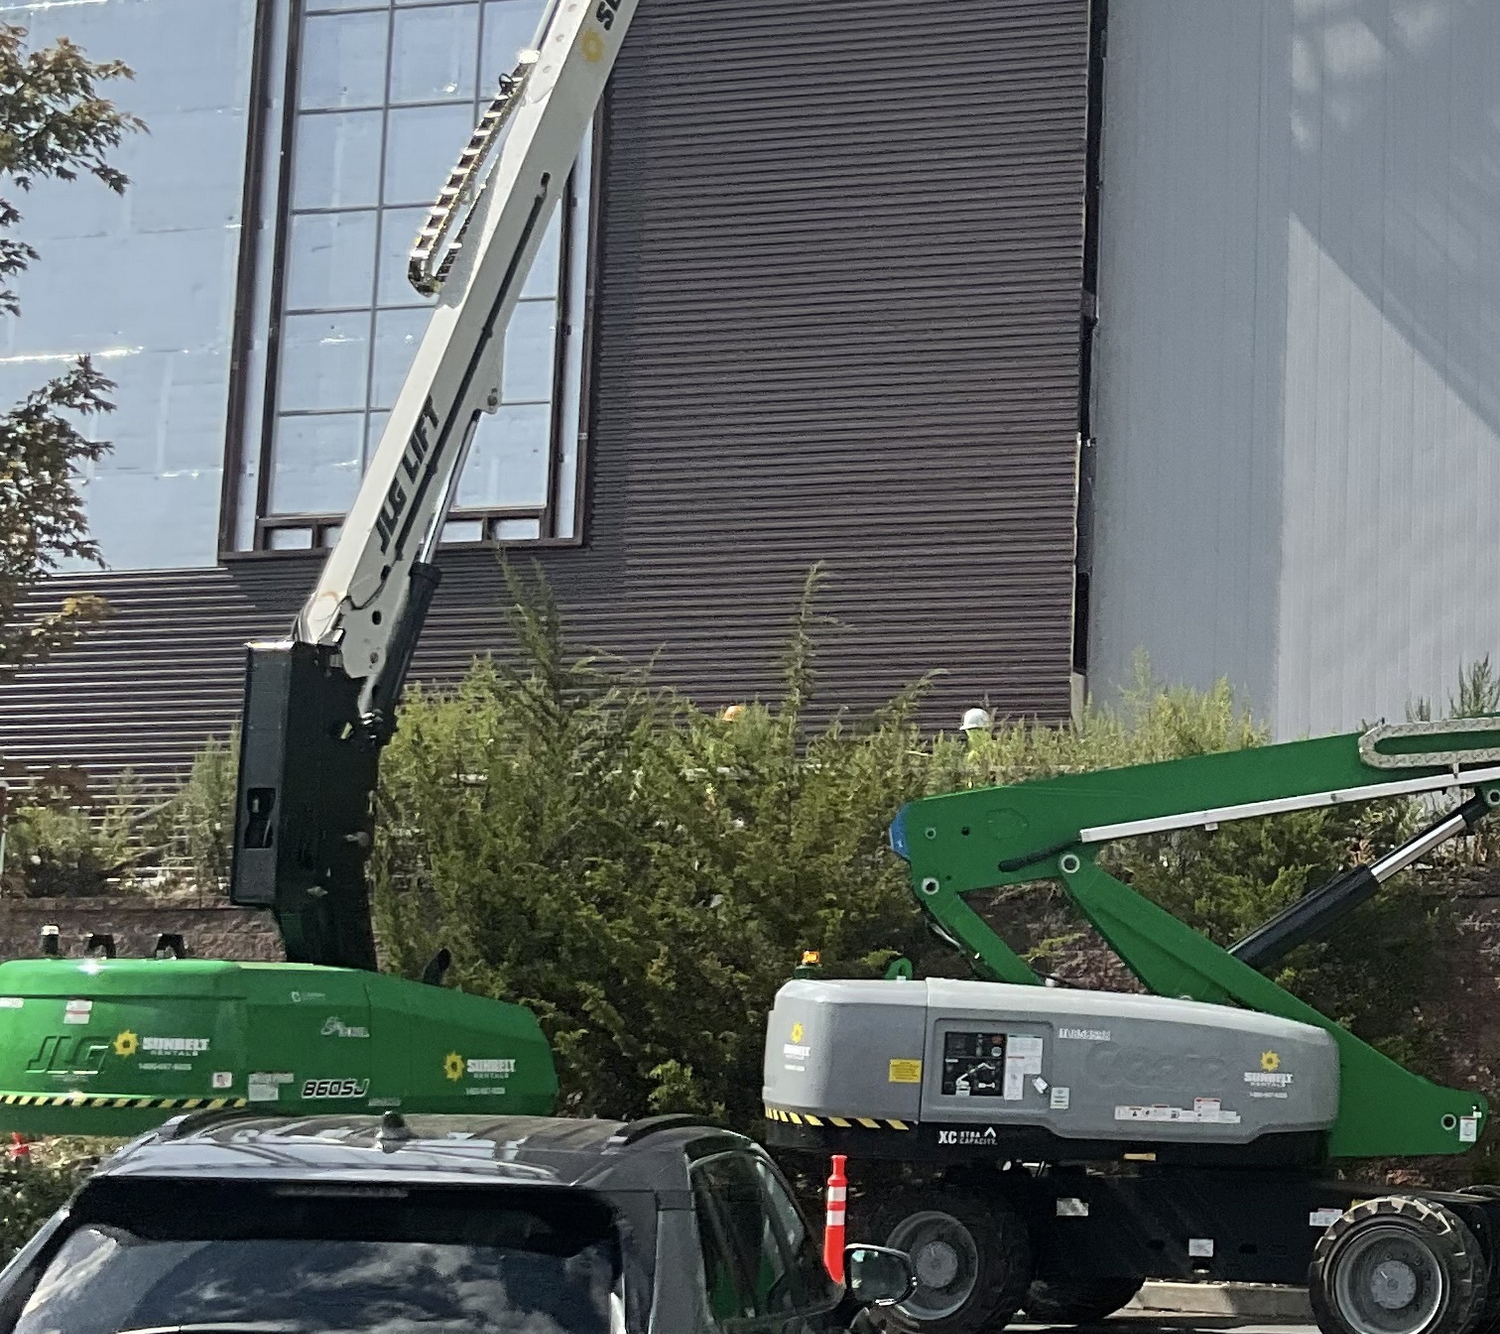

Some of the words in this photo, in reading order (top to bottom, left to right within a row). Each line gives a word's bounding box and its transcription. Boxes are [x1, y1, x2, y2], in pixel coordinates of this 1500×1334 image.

[375, 476, 407, 556] JLG
[401, 395, 440, 485] LIFT
[25, 1035, 112, 1075] JLG
[142, 1037, 210, 1051] SUNBELT
[938, 1130, 958, 1145] XC
